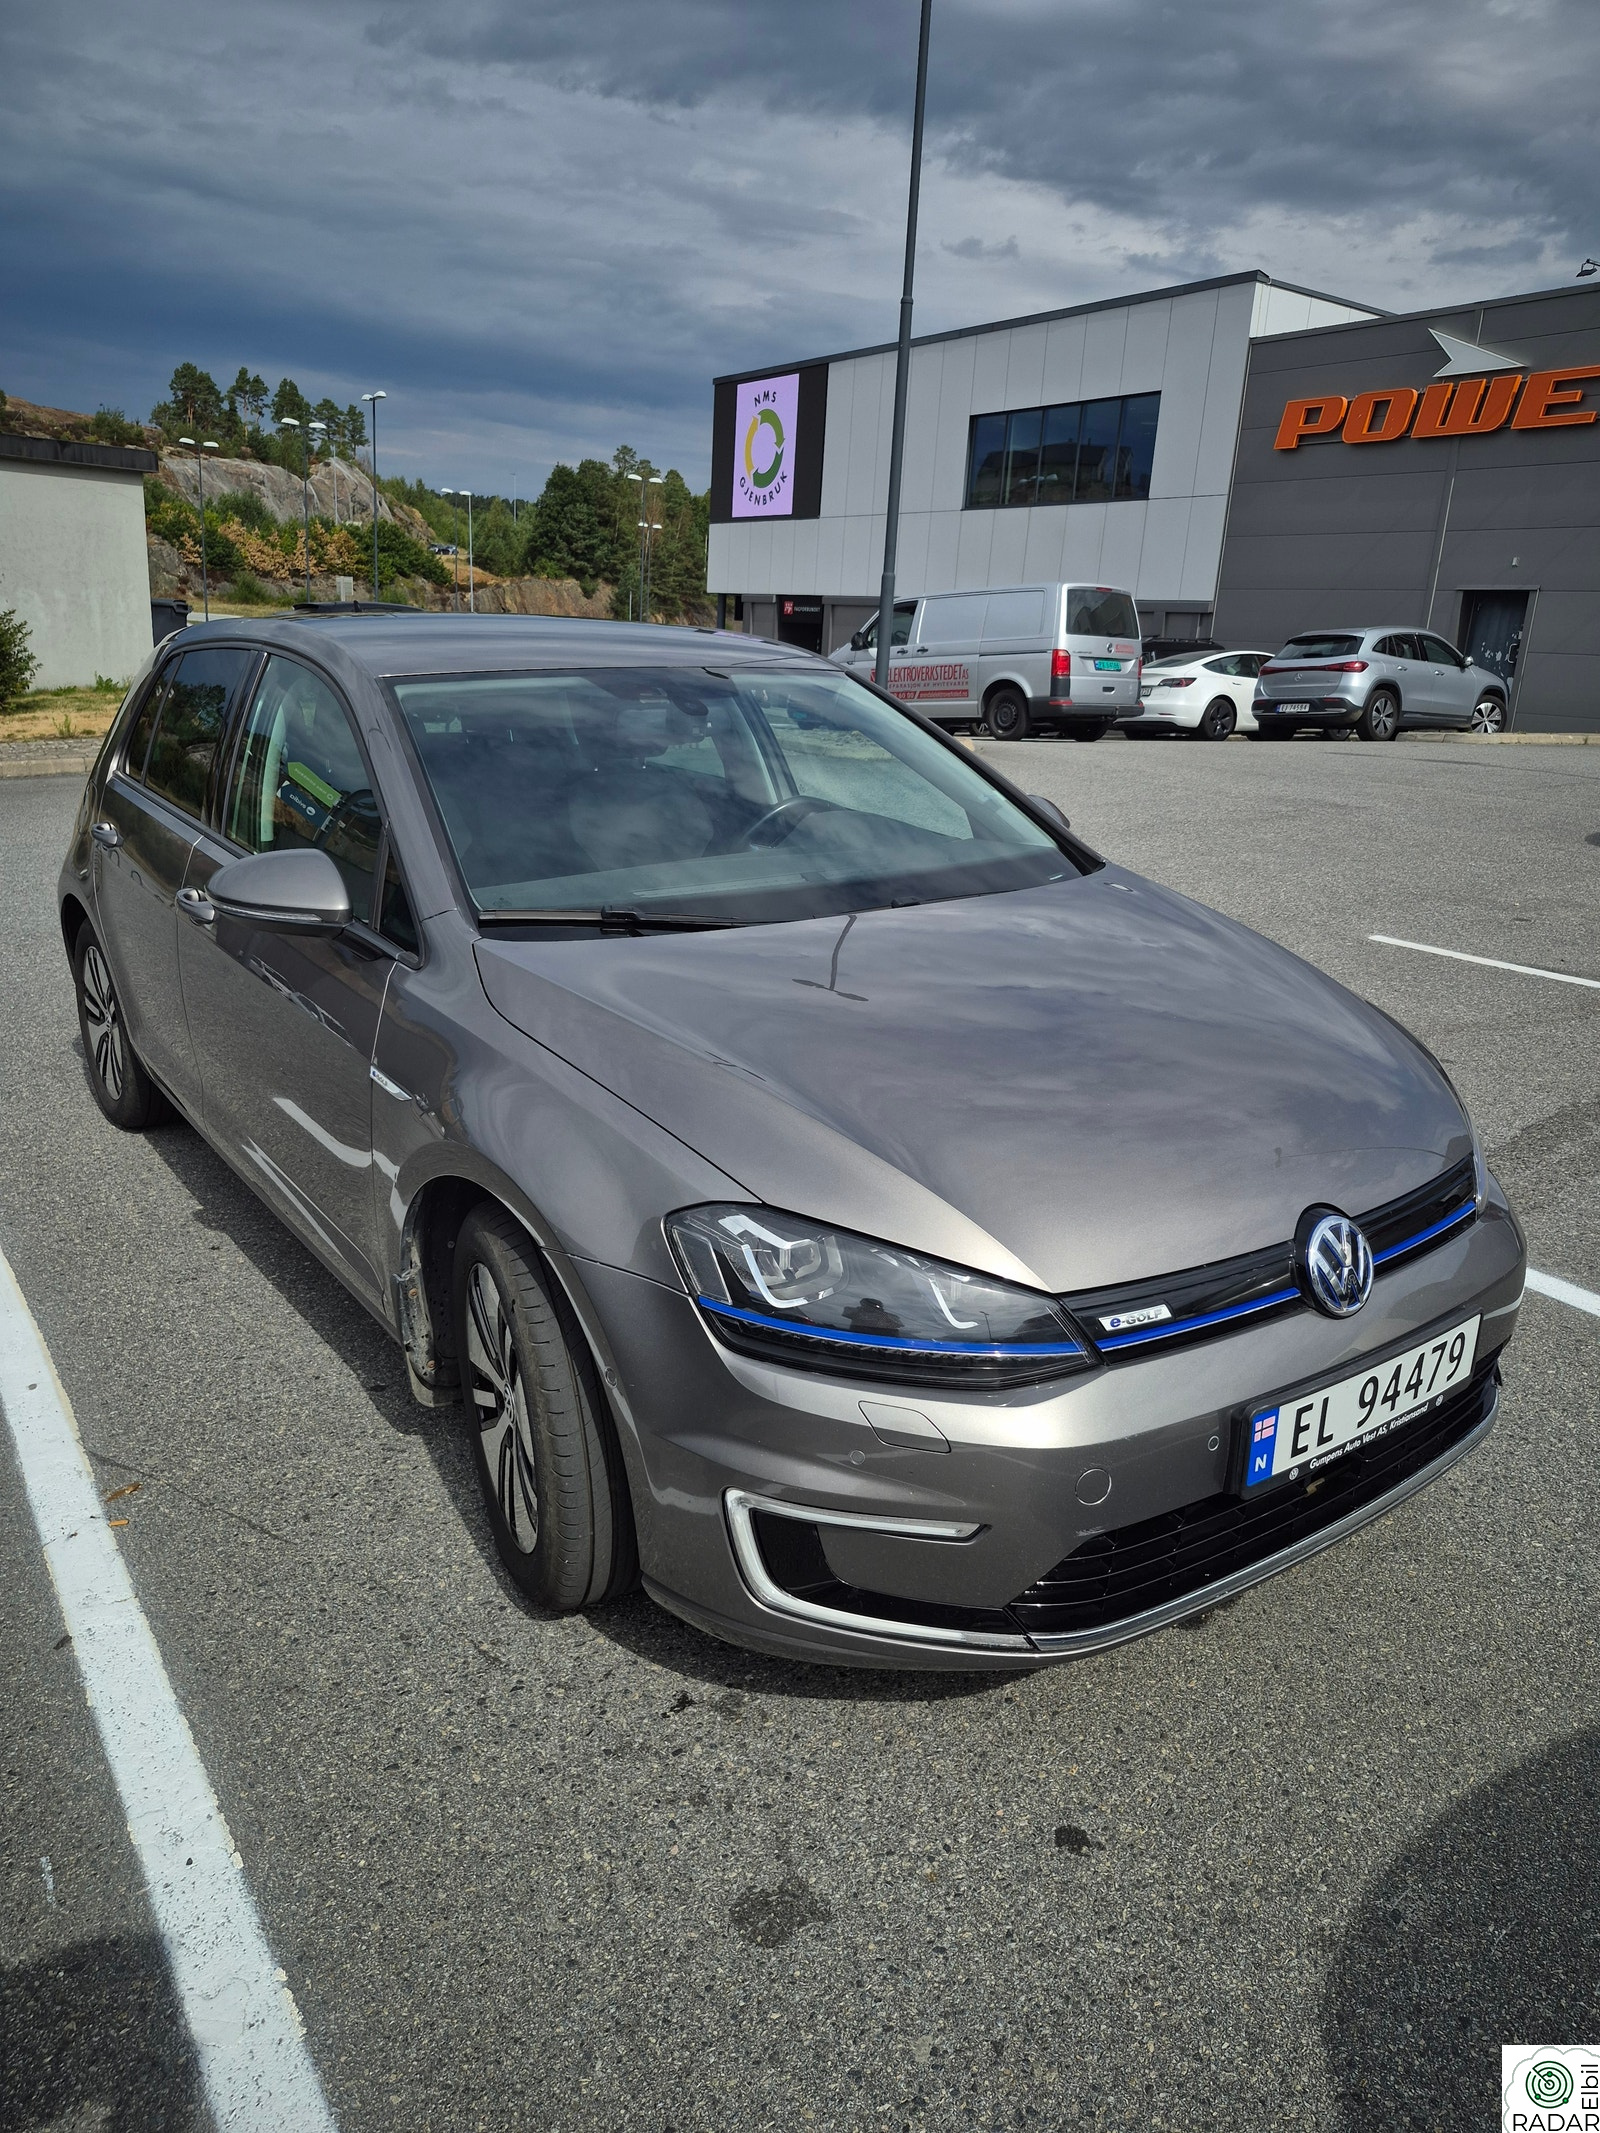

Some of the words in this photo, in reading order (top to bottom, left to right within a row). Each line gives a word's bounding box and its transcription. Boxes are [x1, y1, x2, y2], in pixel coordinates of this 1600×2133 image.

[754, 390, 777, 407] NMS
[740, 472, 787, 506] GJENBRUK
[1110, 1308, 1162, 1328] e-GOLF
[1290, 1396, 1334, 1459] EL
[1356, 1331, 1466, 1429] 94479
[1309, 1447, 1343, 1469] Gumpens
[1344, 1440, 1361, 1453] Auto
[1362, 1430, 1377, 1444] Vest
[1389, 1402, 1429, 1430] Kristiansand
[1254, 1453, 1268, 1472] N
